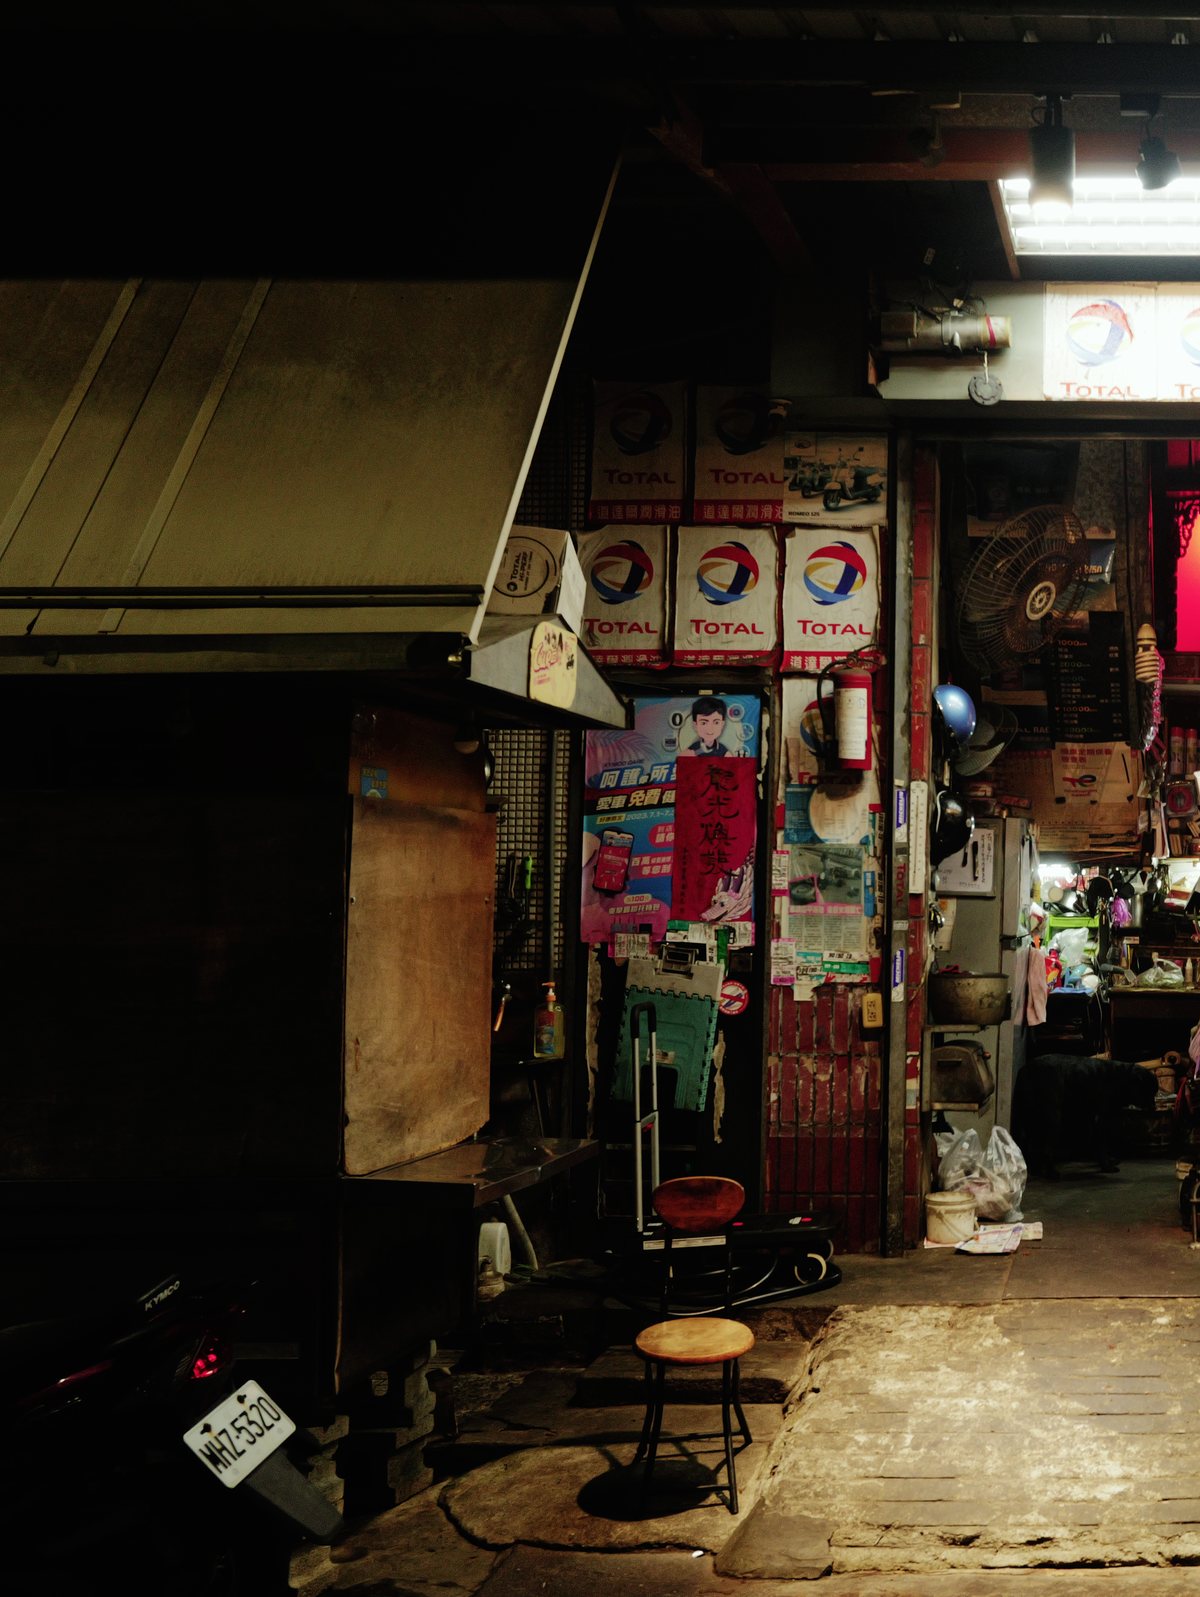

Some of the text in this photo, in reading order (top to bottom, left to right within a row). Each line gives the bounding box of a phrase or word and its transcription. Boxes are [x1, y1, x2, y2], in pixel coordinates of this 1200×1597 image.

[1060, 382, 1140, 398] TOTAL
[603, 468, 677, 485] TOTAL
[710, 469, 785, 485] TOTAL
[510, 552, 522, 580] TOTAL
[584, 618, 658, 635] TOTAL
[690, 619, 764, 636] TOTAL
[797, 619, 871, 636] TOTAL
[896, 862, 906, 906] TOTAL
[198, 1396, 281, 1474] MHZ-5320
